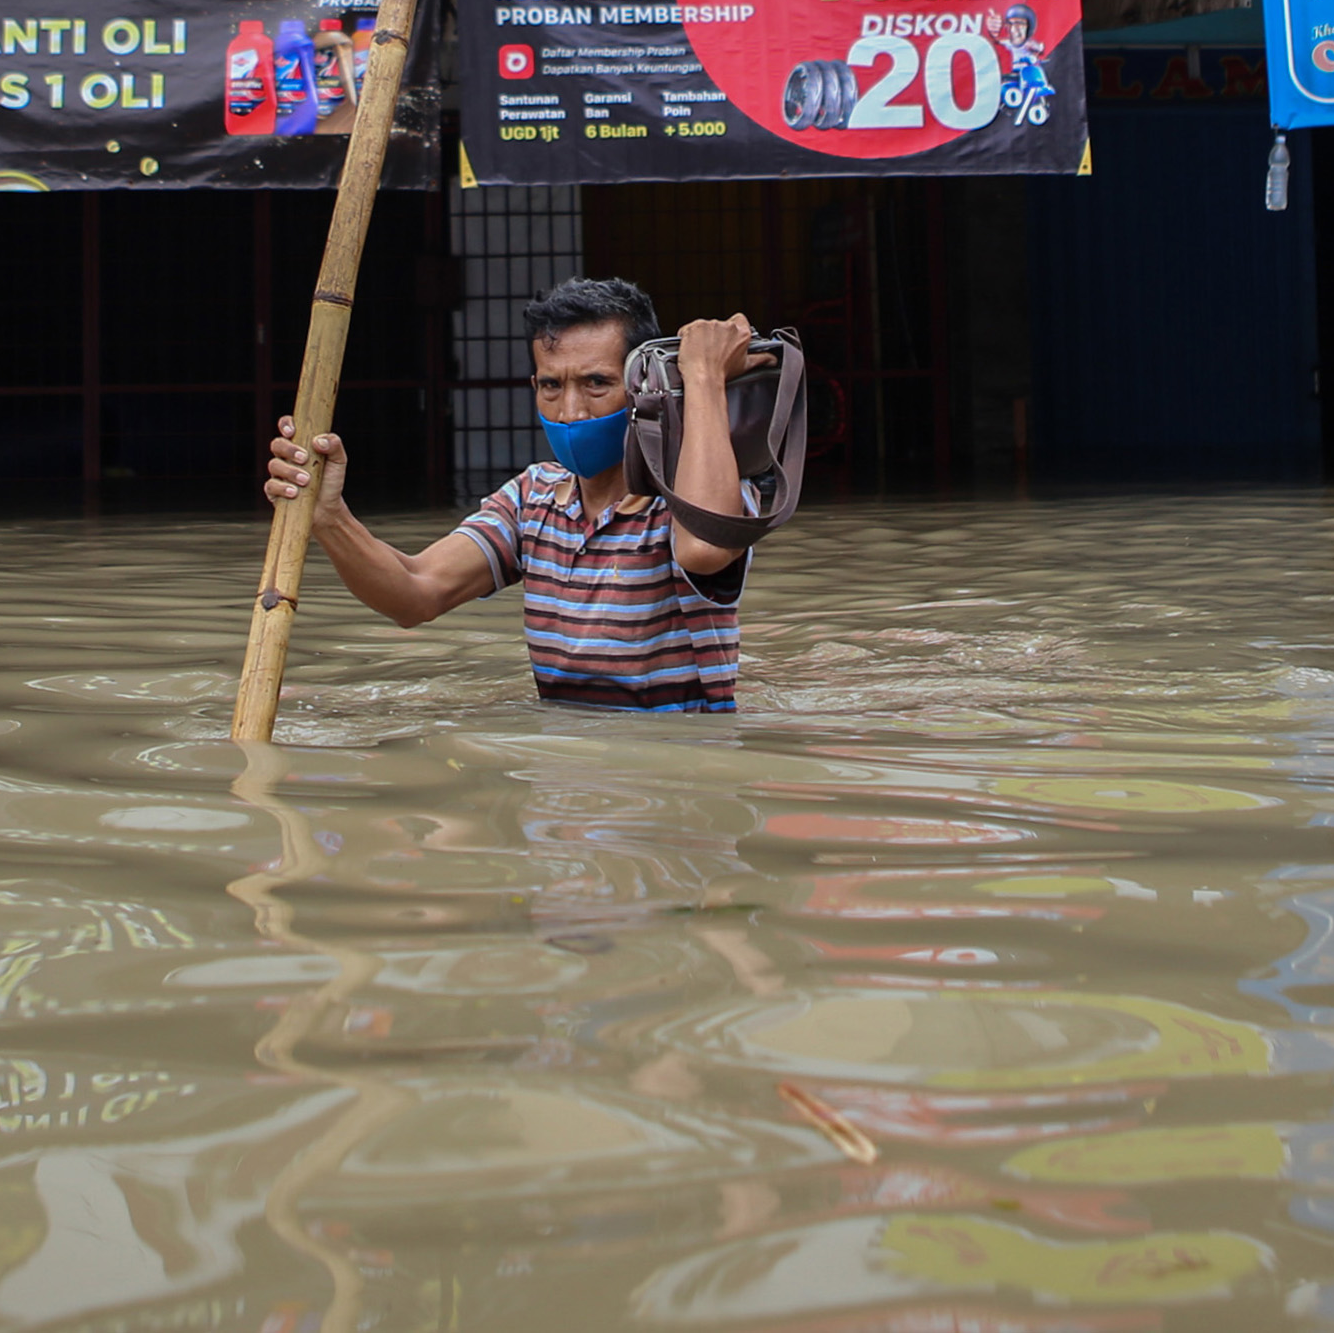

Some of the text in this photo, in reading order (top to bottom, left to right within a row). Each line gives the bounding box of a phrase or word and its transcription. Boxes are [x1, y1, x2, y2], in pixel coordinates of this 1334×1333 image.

[495, 4, 755, 26] PROBAN MEMBERSHIP
[861, 12, 983, 36] DISKON
[102, 17, 187, 56] OLI
[541, 45, 686, 59] Daftar Membership Proban
[542, 62, 703, 76] Dapatkan Banyak Keuntungan
[44, 73, 65, 110] 1
[79, 73, 165, 111] OLI
[583, 92, 633, 104] Garansi
[662, 90, 727, 103] Tambahan
[499, 94, 559, 106] Santunan
[500, 108, 566, 121] Perawatan
[585, 107, 610, 119] Ban
[663, 106, 692, 117] Poin
[500, 124, 560, 143] UGD 1jt
[585, 123, 648, 139] 6 Bulan
[678, 122, 727, 137] 5.000
